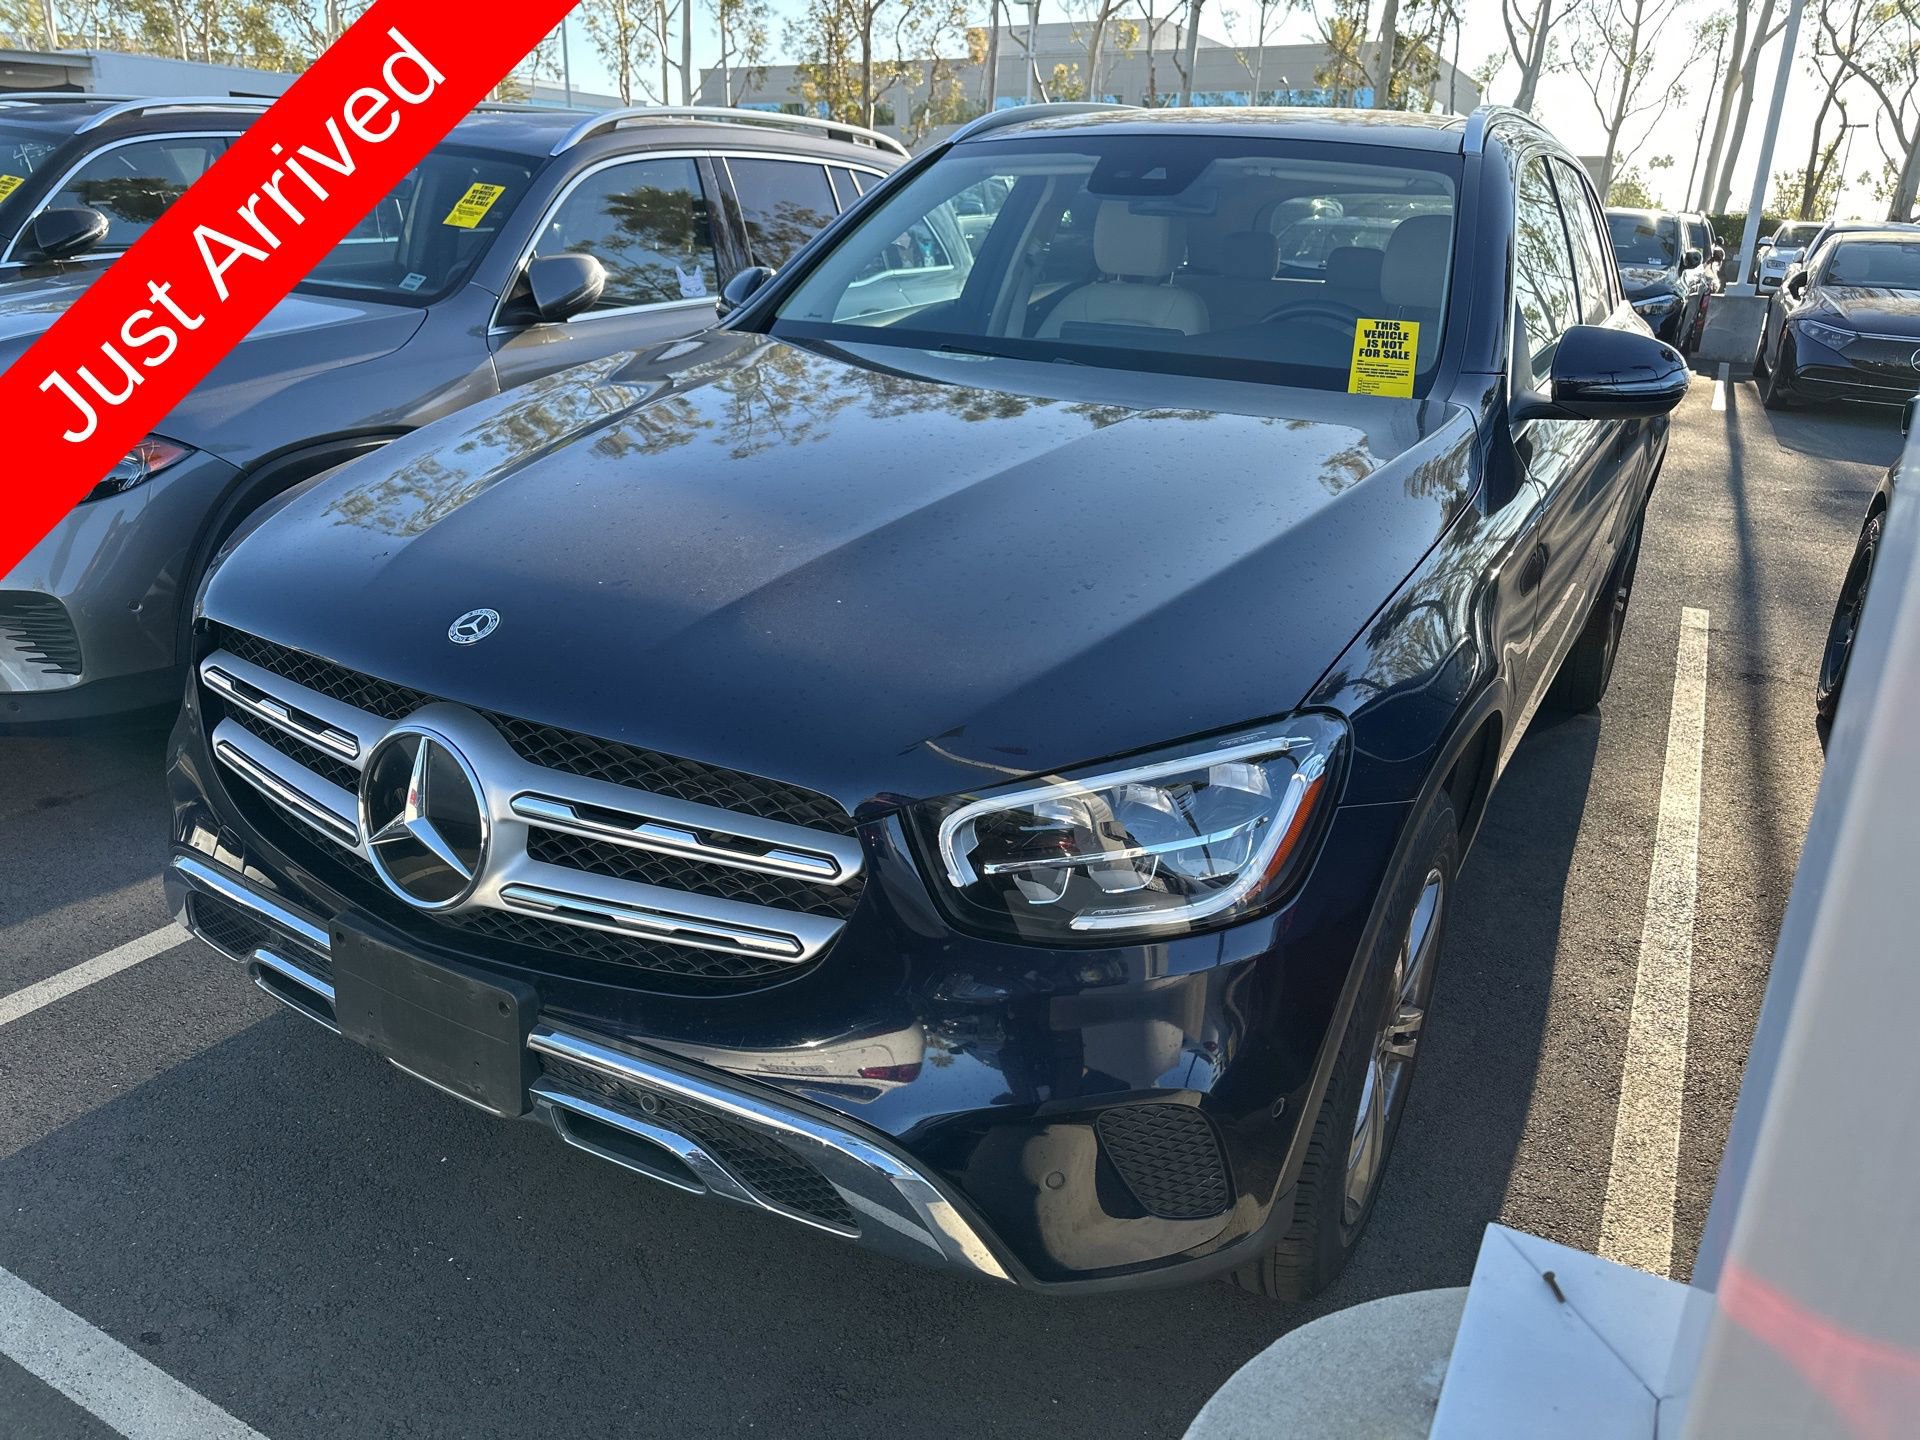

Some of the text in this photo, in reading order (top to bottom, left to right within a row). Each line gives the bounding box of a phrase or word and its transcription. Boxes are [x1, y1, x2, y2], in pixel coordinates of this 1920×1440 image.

[1374, 321, 1400, 331] THIS
[1364, 330, 1409, 341] VEHICLE
[1367, 339, 1404, 350] IS NOT
[1359, 348, 1410, 360] FOR SALE
